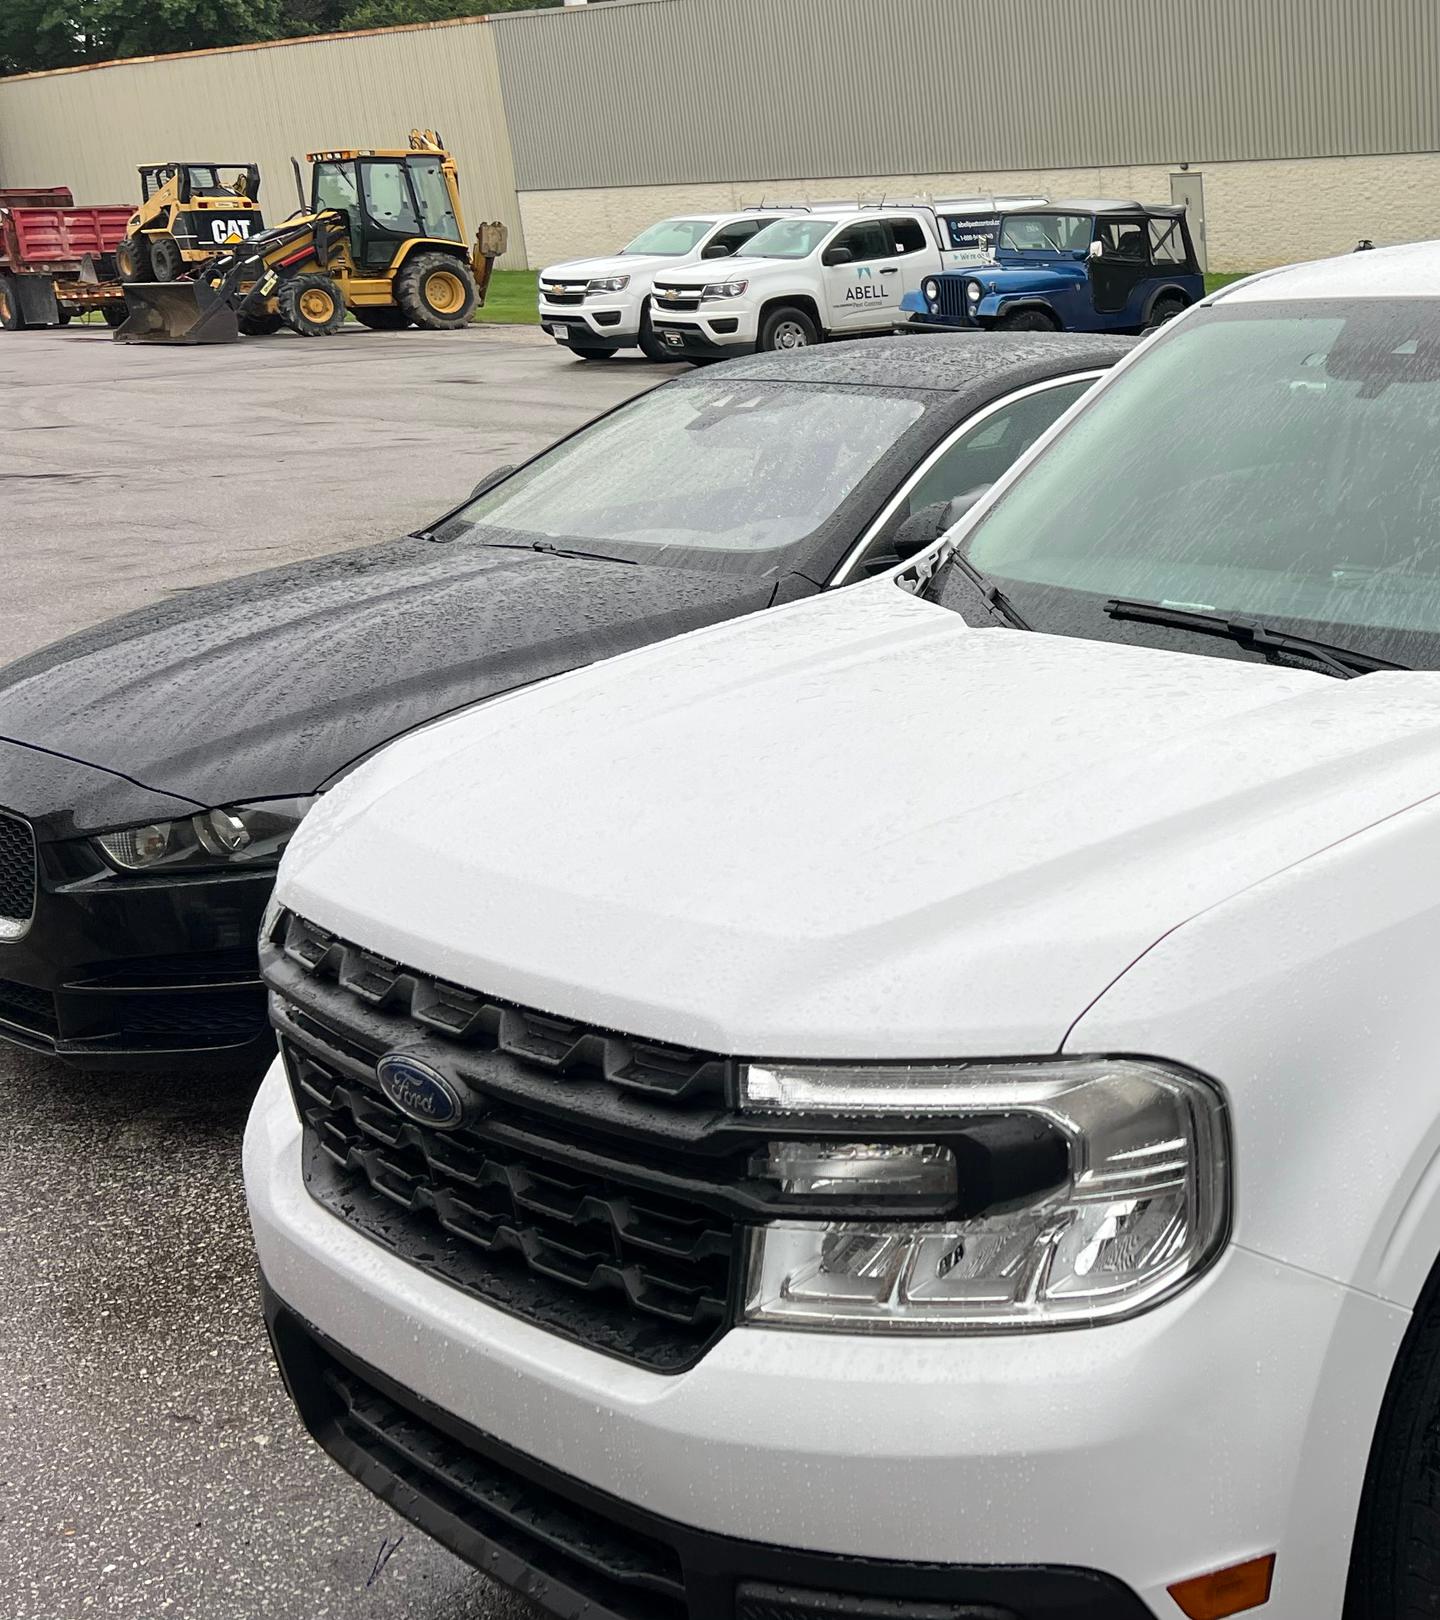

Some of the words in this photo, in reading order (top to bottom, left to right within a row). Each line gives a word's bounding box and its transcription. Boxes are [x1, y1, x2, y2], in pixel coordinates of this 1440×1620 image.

[211, 219, 250, 244] CAT
[846, 284, 889, 300] ABELL
[391, 1070, 436, 1114] Ford
